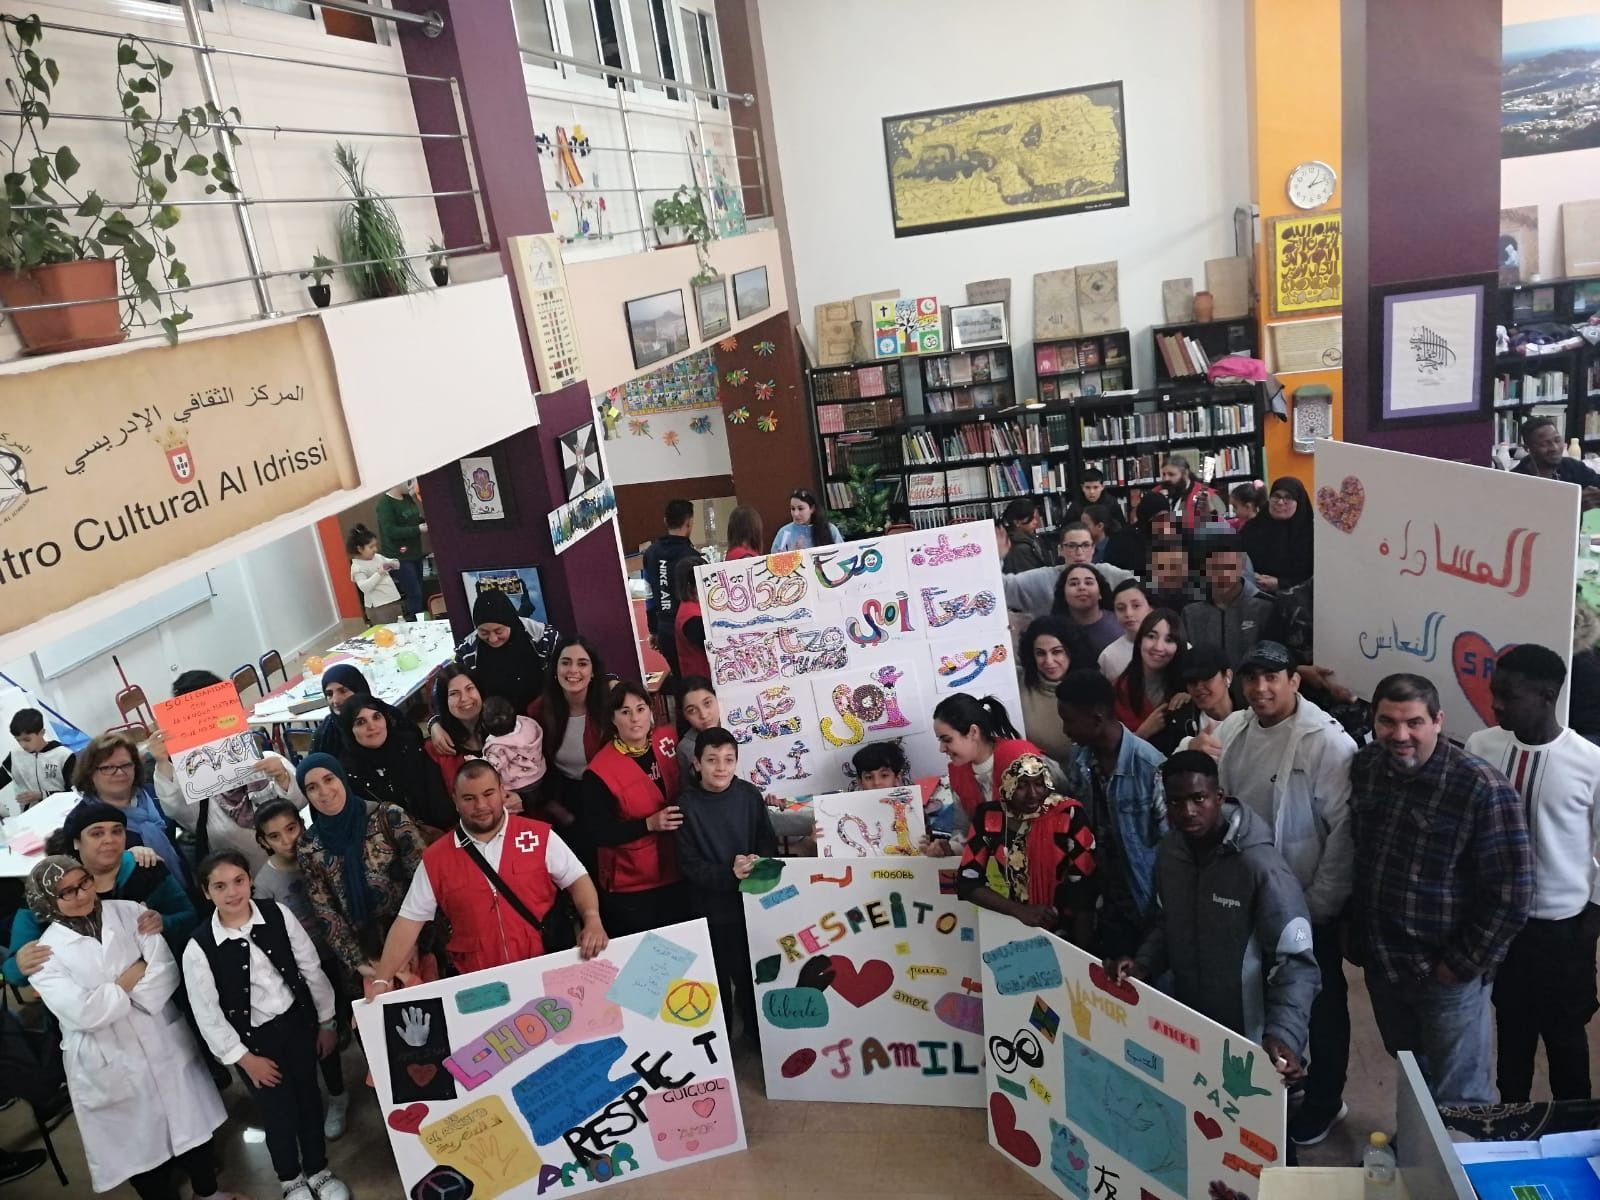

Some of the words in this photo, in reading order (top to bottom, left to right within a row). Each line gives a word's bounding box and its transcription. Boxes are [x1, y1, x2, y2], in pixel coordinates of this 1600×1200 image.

[173, 387, 234, 423] الثقافي
[246, 384, 304, 407] المركز
[64, 404, 162, 476] الإدريسي
[73, 479, 209, 552] Cultural
[219, 467, 247, 501] Al
[253, 437, 328, 486] Idrissi
[659, 559, 669, 587] NIKE
[660, 590, 672, 611] AIR
[778, 892, 957, 963] RESPEITO
[822, 1038, 986, 1079] FAMIL
